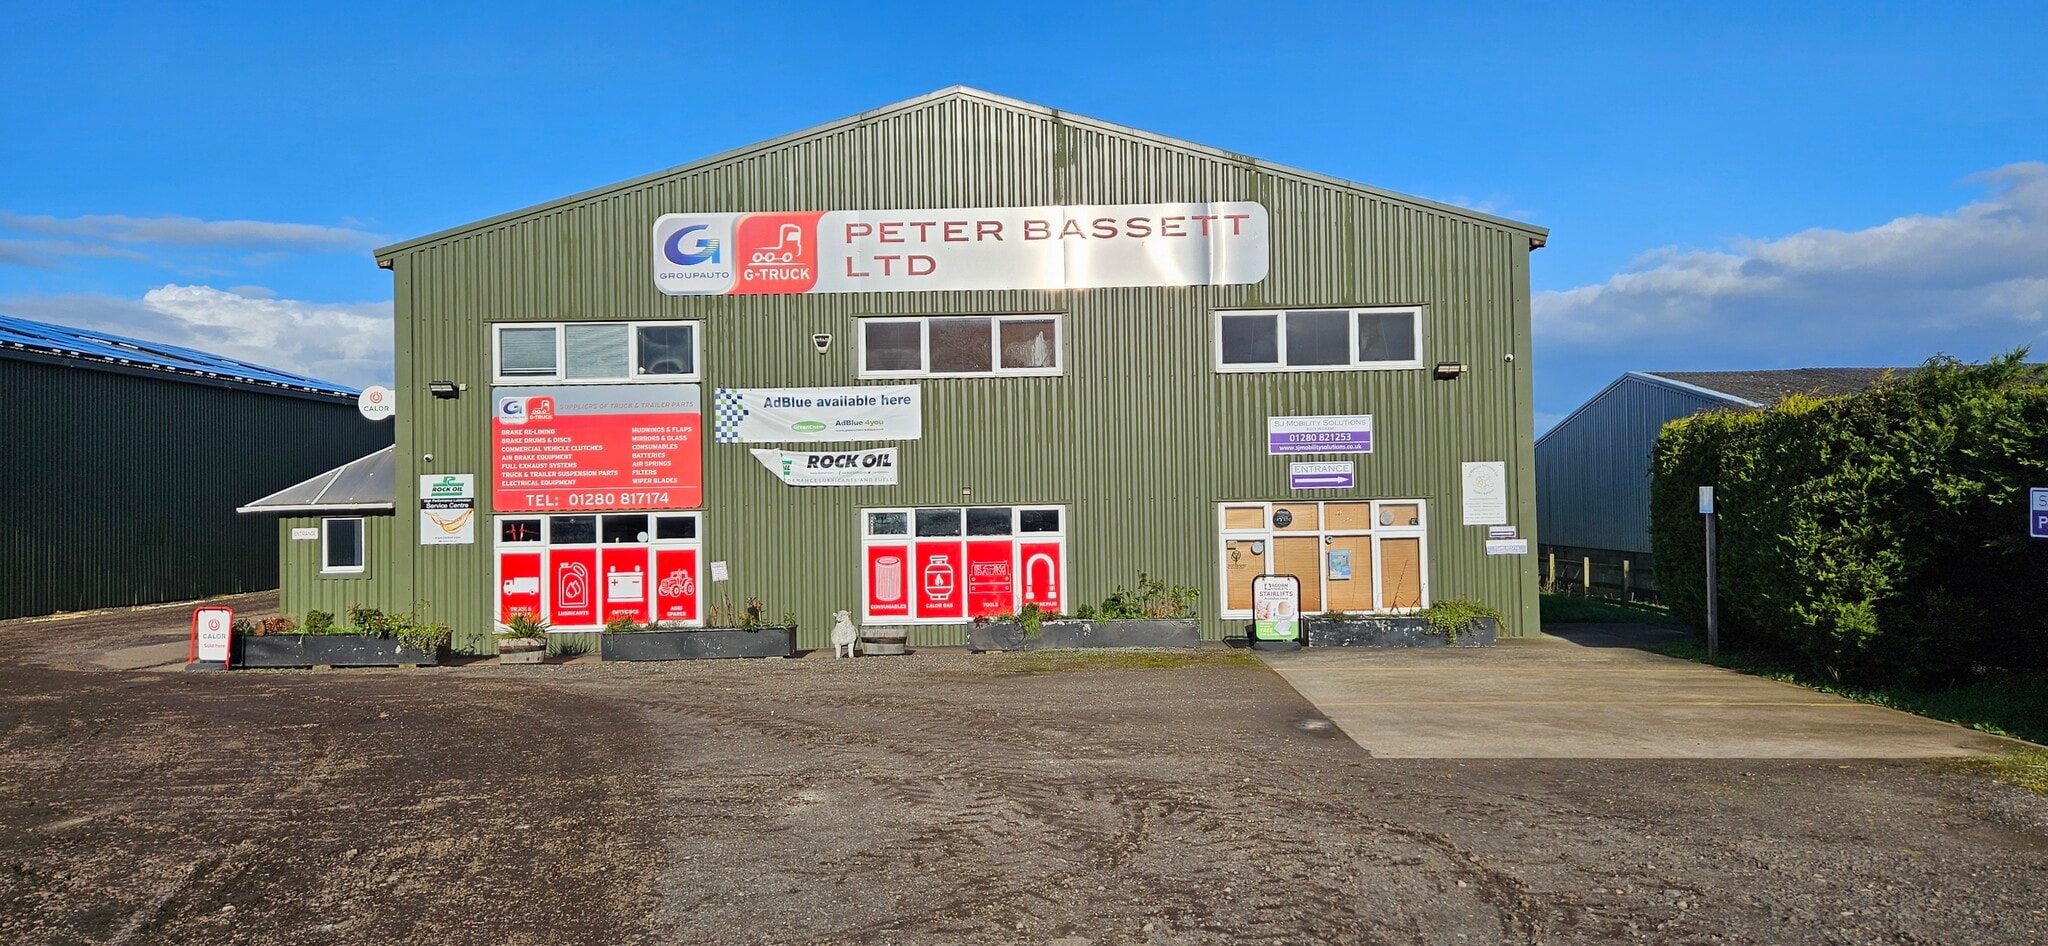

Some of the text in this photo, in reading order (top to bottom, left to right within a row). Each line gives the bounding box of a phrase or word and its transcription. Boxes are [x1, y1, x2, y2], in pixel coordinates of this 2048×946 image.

[845, 213, 1250, 244] PETER BASSETT
[846, 254, 937, 277] LTD
[659, 271, 730, 280] GROUPAUTO
[743, 268, 811, 281] G-TRUCK
[763, 394, 912, 408] AdBlue available here
[864, 419, 884, 427] 4you
[1289, 432, 1352, 442] 01280 821253
[1279, 443, 1362, 451] www.sjmobilitysolutions.co.uk
[807, 454, 892, 468] ROCK OIL
[1294, 465, 1350, 473] ENTRANCE
[526, 492, 669, 506] TEL: 01280 817174
